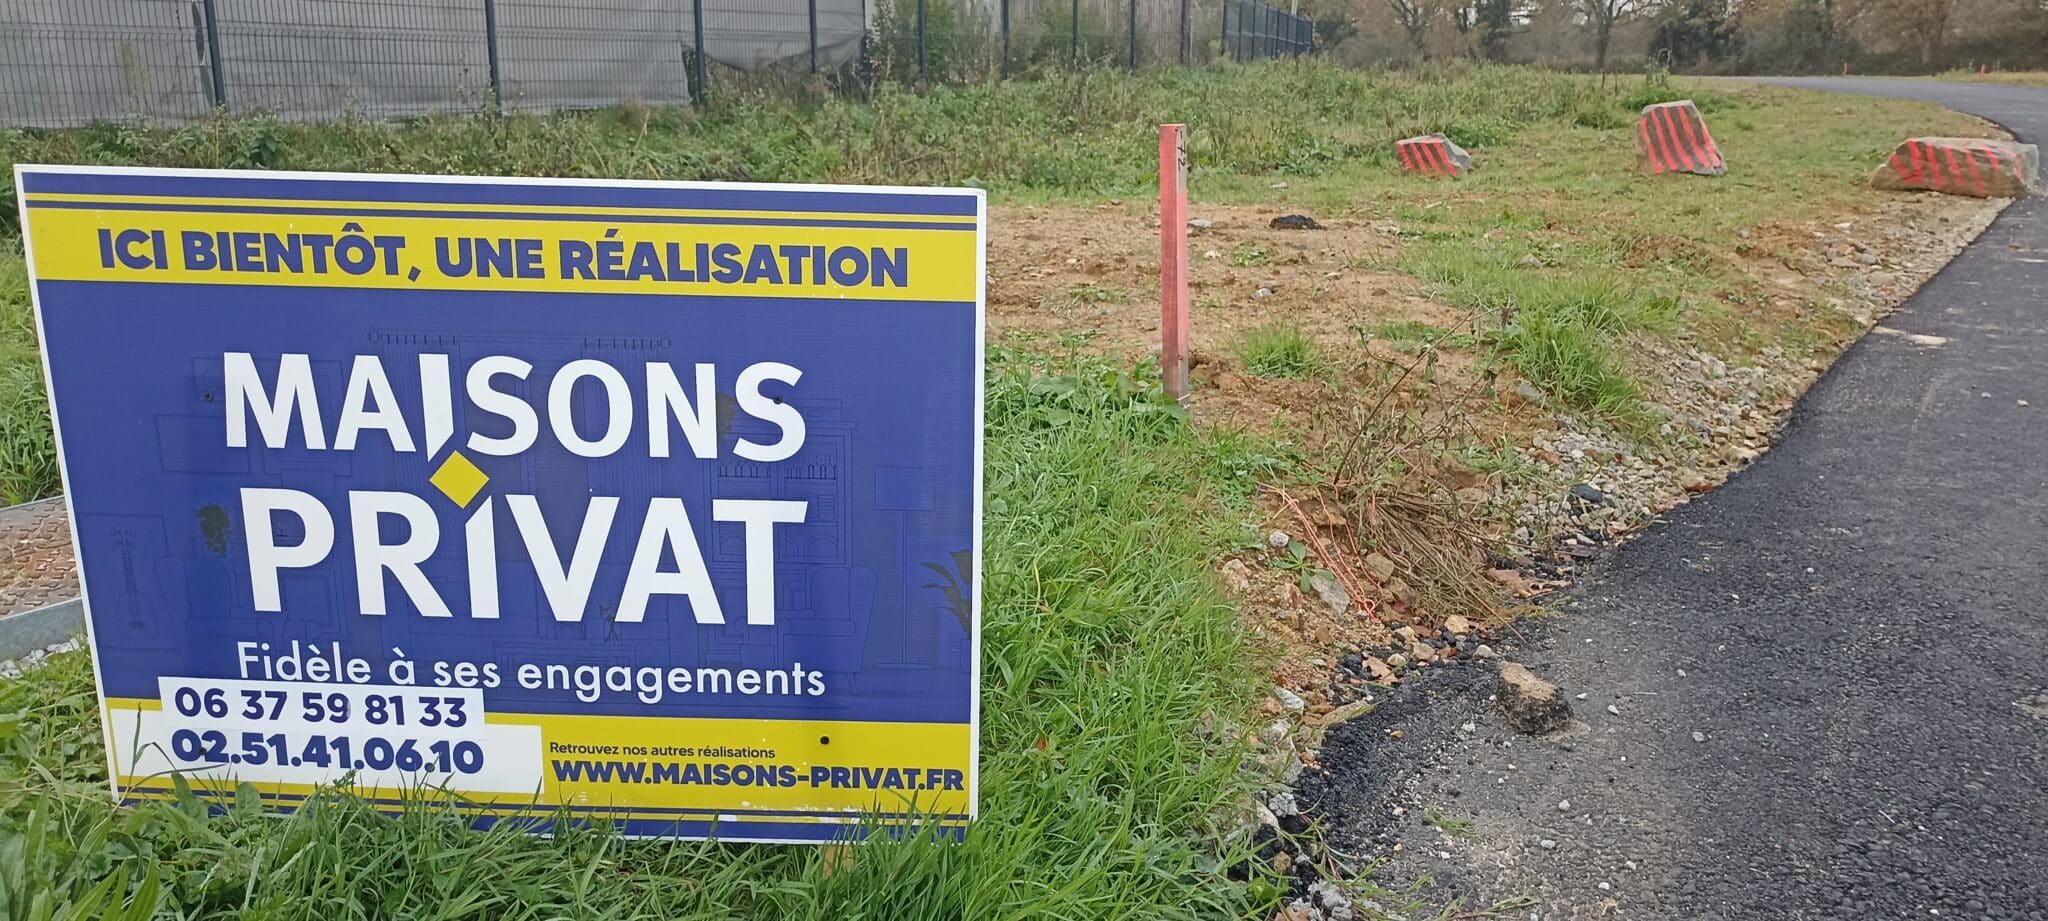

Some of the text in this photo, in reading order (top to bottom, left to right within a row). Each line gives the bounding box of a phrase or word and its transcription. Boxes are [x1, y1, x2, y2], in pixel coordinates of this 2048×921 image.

[98, 222, 908, 288] ICI BIENTÔT, UNE RÉALISATION
[224, 352, 806, 463] MAISONS
[237, 640, 826, 704] Fidèle à ses engagements
[174, 686, 467, 728] 06 37 59 81 33
[171, 728, 484, 775] 02.51.41.06.10
[549, 742, 776, 759] Retrouvez nos autres réalisations
[551, 760, 964, 791] WWW.MAISONS-PRIVAT.FR
